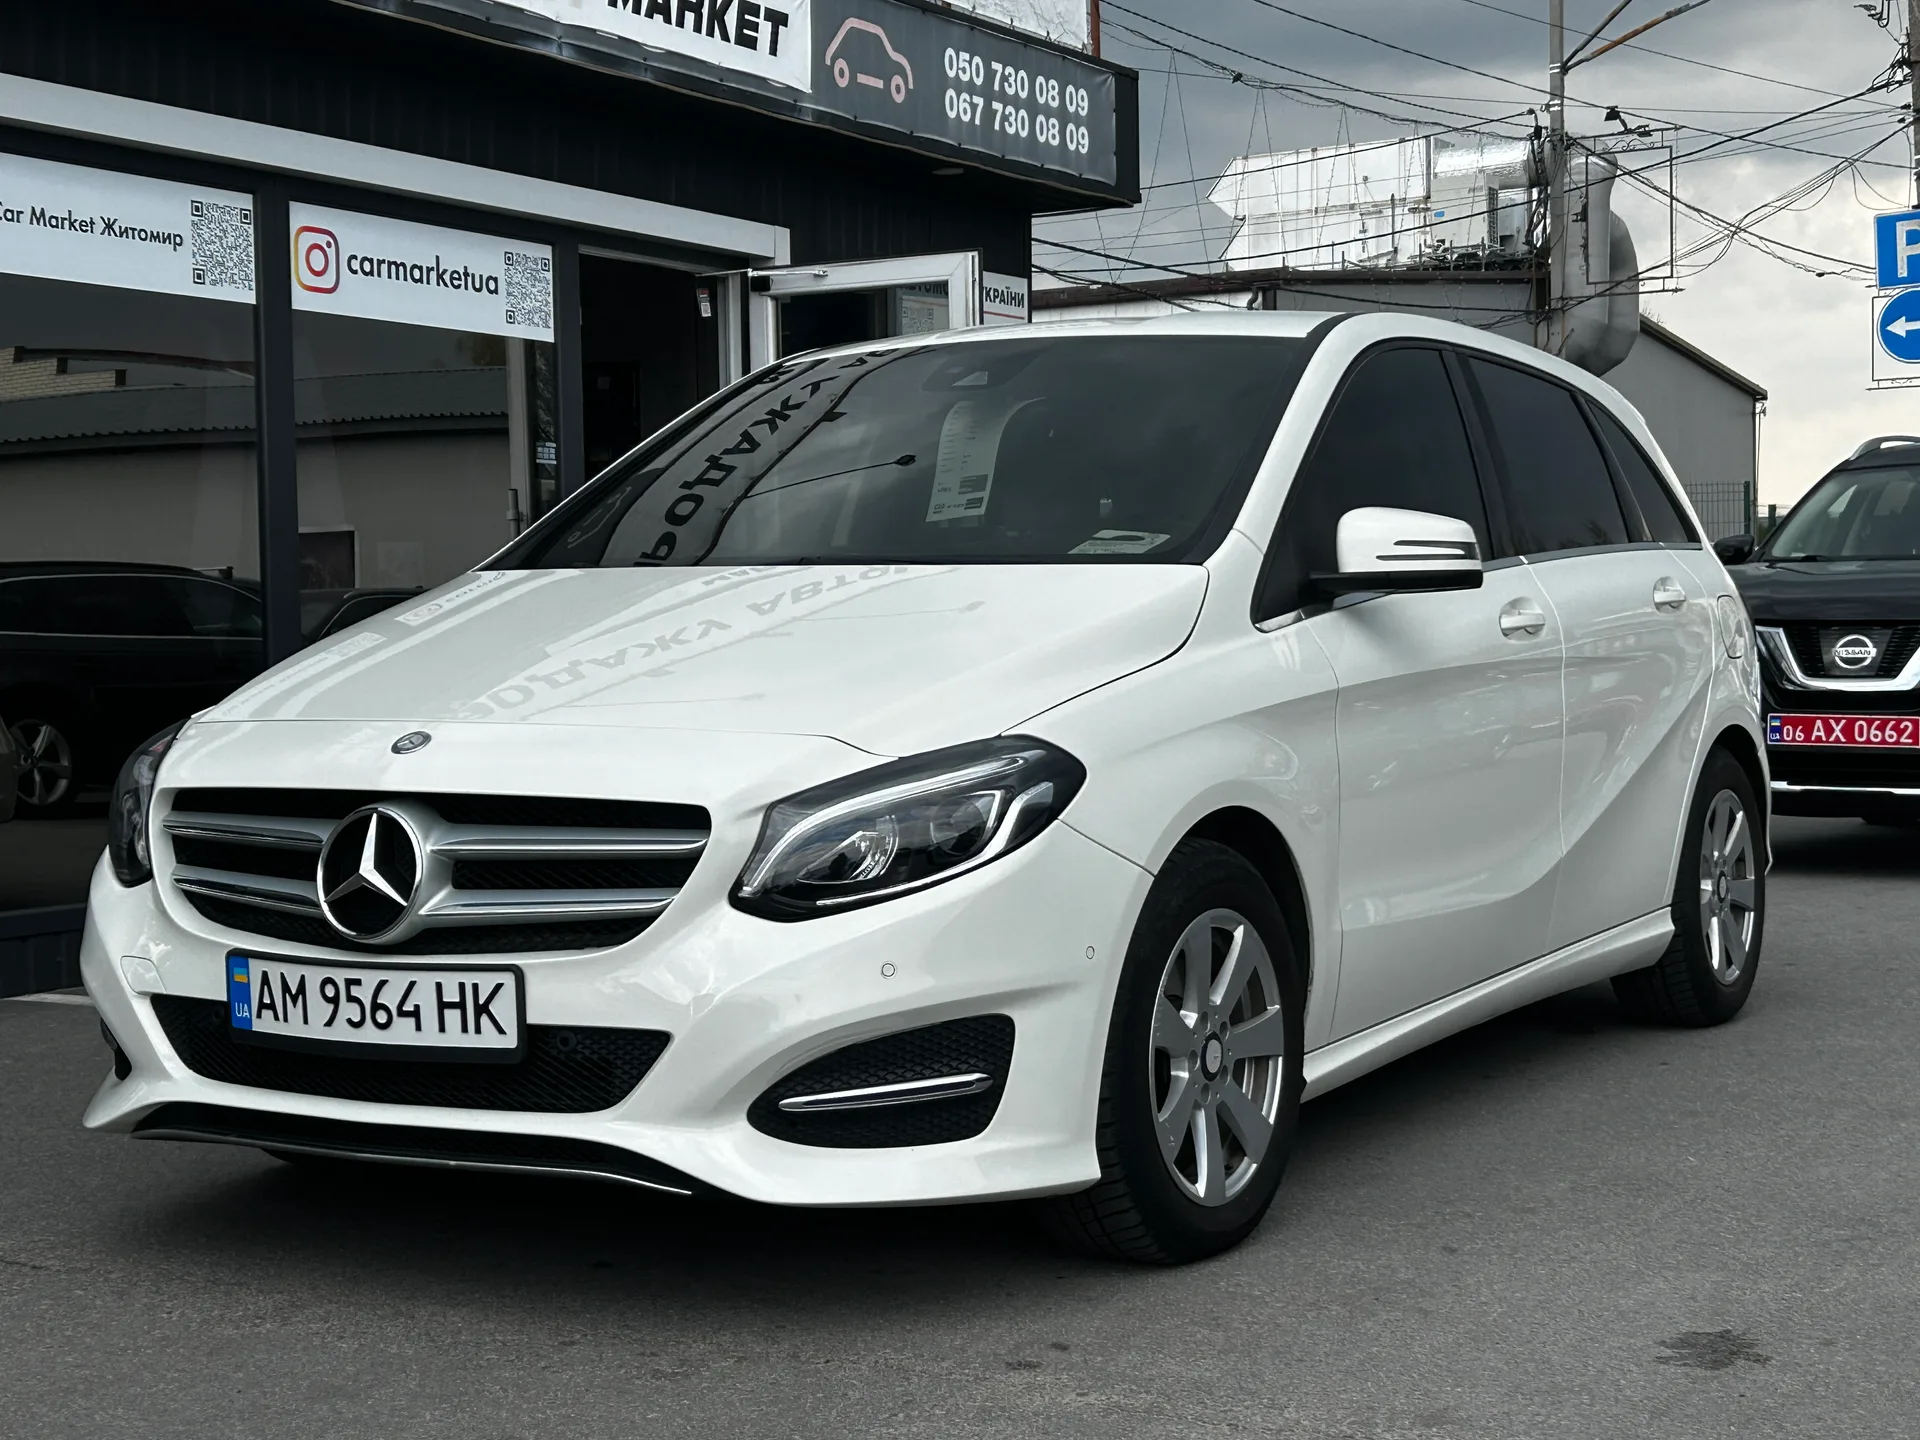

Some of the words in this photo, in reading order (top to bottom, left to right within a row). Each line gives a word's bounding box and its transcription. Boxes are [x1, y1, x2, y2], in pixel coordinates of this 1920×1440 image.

[944, 47, 984, 86] 050
[991, 60, 1029, 99] 730
[1035, 75, 1060, 108] 08
[1065, 84, 1089, 117] 09
[944, 88, 984, 126] 067
[991, 100, 1029, 138] 730
[1035, 114, 1060, 146] 08
[1065, 122, 1090, 154] 09
[0, 202, 25, 223] ar
[29, 205, 96, 234] Market
[100, 215, 184, 252] Житомир
[346, 253, 499, 295] carmarketua
[1834, 648, 1872, 656] NISSAN
[1769, 732, 1781, 740] UA
[1783, 725, 1805, 741] 06
[1811, 719, 1847, 742] AX
[1854, 720, 1914, 743] 0662
[235, 1001, 250, 1018] UA
[256, 970, 309, 1025] AM
[319, 976, 422, 1031] 9564
[435, 981, 507, 1035] HK
